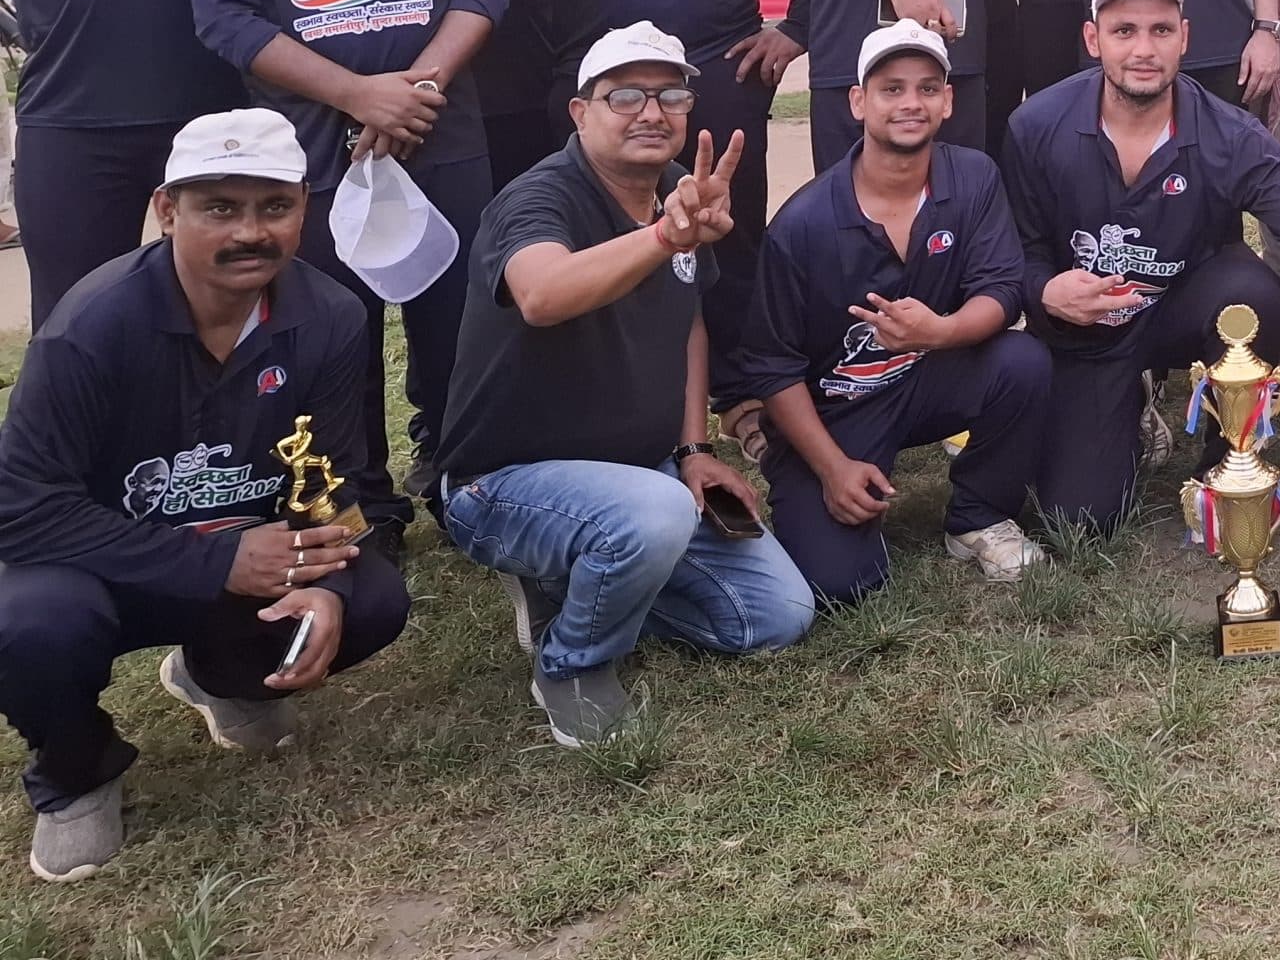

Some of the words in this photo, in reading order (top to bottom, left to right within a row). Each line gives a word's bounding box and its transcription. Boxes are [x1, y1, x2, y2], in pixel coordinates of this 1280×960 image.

[1100, 258, 1114, 272] ही
[1150, 262, 1184, 274] 2024
[173, 467, 250, 490] स्वच्छता
[164, 491, 189, 513] ही
[193, 487, 240, 506] सेवा
